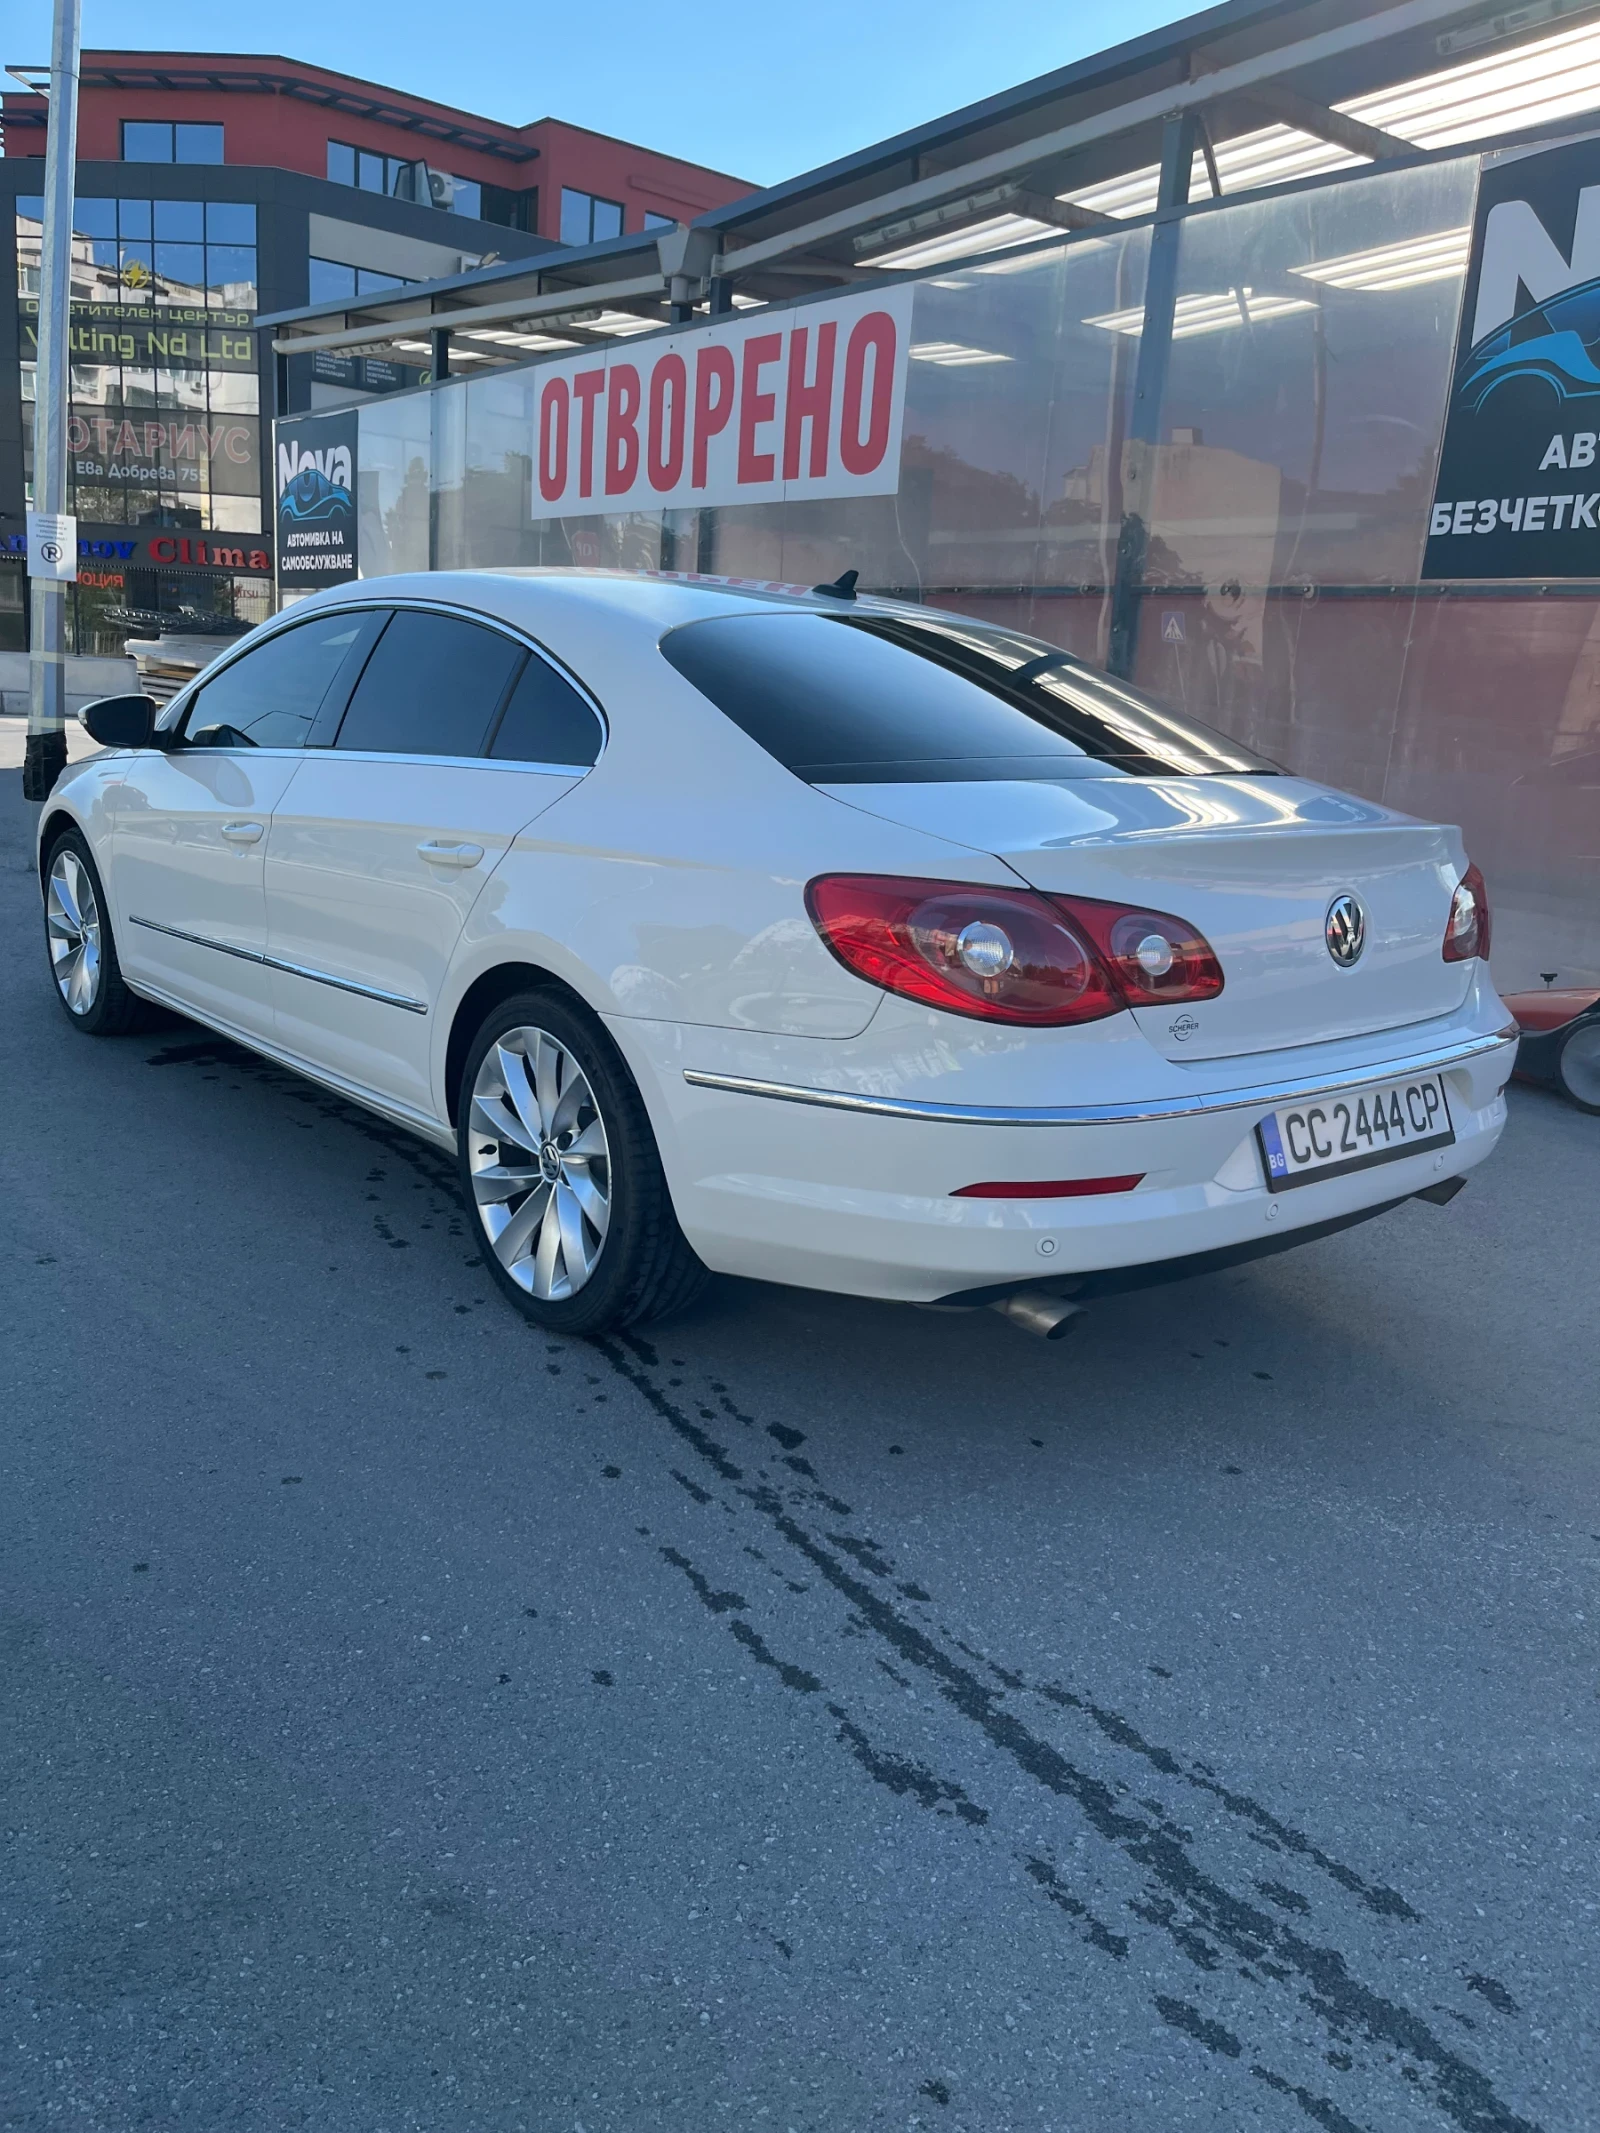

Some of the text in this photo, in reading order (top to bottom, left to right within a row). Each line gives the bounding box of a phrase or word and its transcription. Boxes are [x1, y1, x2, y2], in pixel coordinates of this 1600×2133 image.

[26, 300, 249, 327] оетителен център
[25, 326, 252, 361] Vlting Nd Ltd
[539, 311, 897, 502] ОТВОРЕНО
[67, 416, 251, 464] ОТАРИУС
[1539, 431, 1600, 472] АВ
[108, 463, 176, 481] Добрева
[181, 468, 208, 482] 755
[278, 440, 352, 502] Nova
[1429, 493, 1600, 536] БЕЗЧЕТК
[148, 536, 272, 570] Clima
[287, 530, 344, 548] АВТОМИВКА НА
[282, 553, 353, 571] САМООБСЛУЖВАНЕ
[1168, 1022, 1199, 1033] SCHERER
[1268, 1153, 1285, 1169] BG
